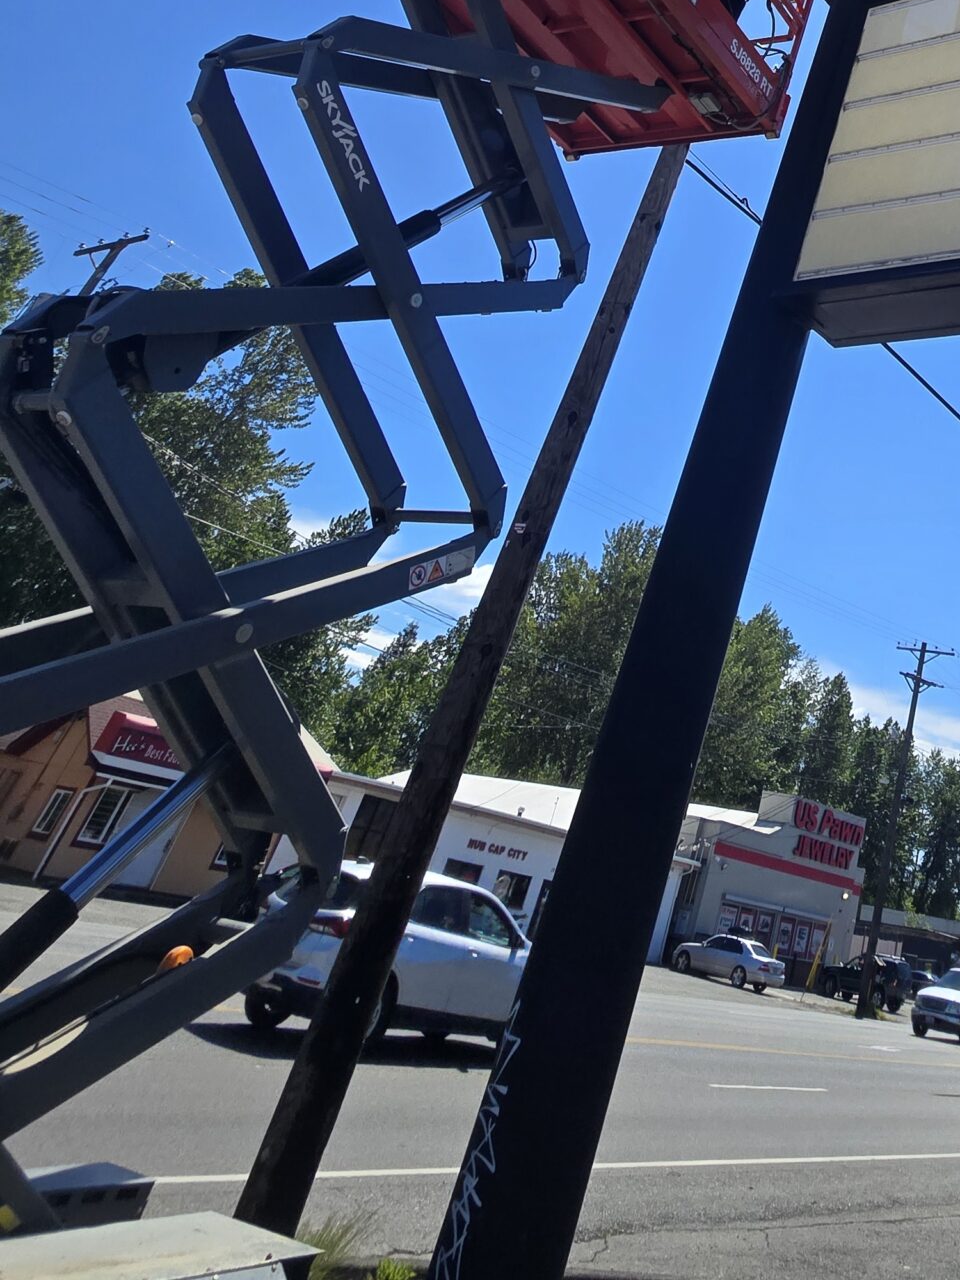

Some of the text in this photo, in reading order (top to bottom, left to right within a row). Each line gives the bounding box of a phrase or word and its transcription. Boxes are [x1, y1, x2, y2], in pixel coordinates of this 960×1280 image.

[760, 76, 773, 97] RT
[316, 80, 371, 193] SKYJACK
[794, 799, 865, 846] US Pawn
[467, 838, 529, 861] HUB CAP CITY
[792, 834, 855, 870] JEWELRY
